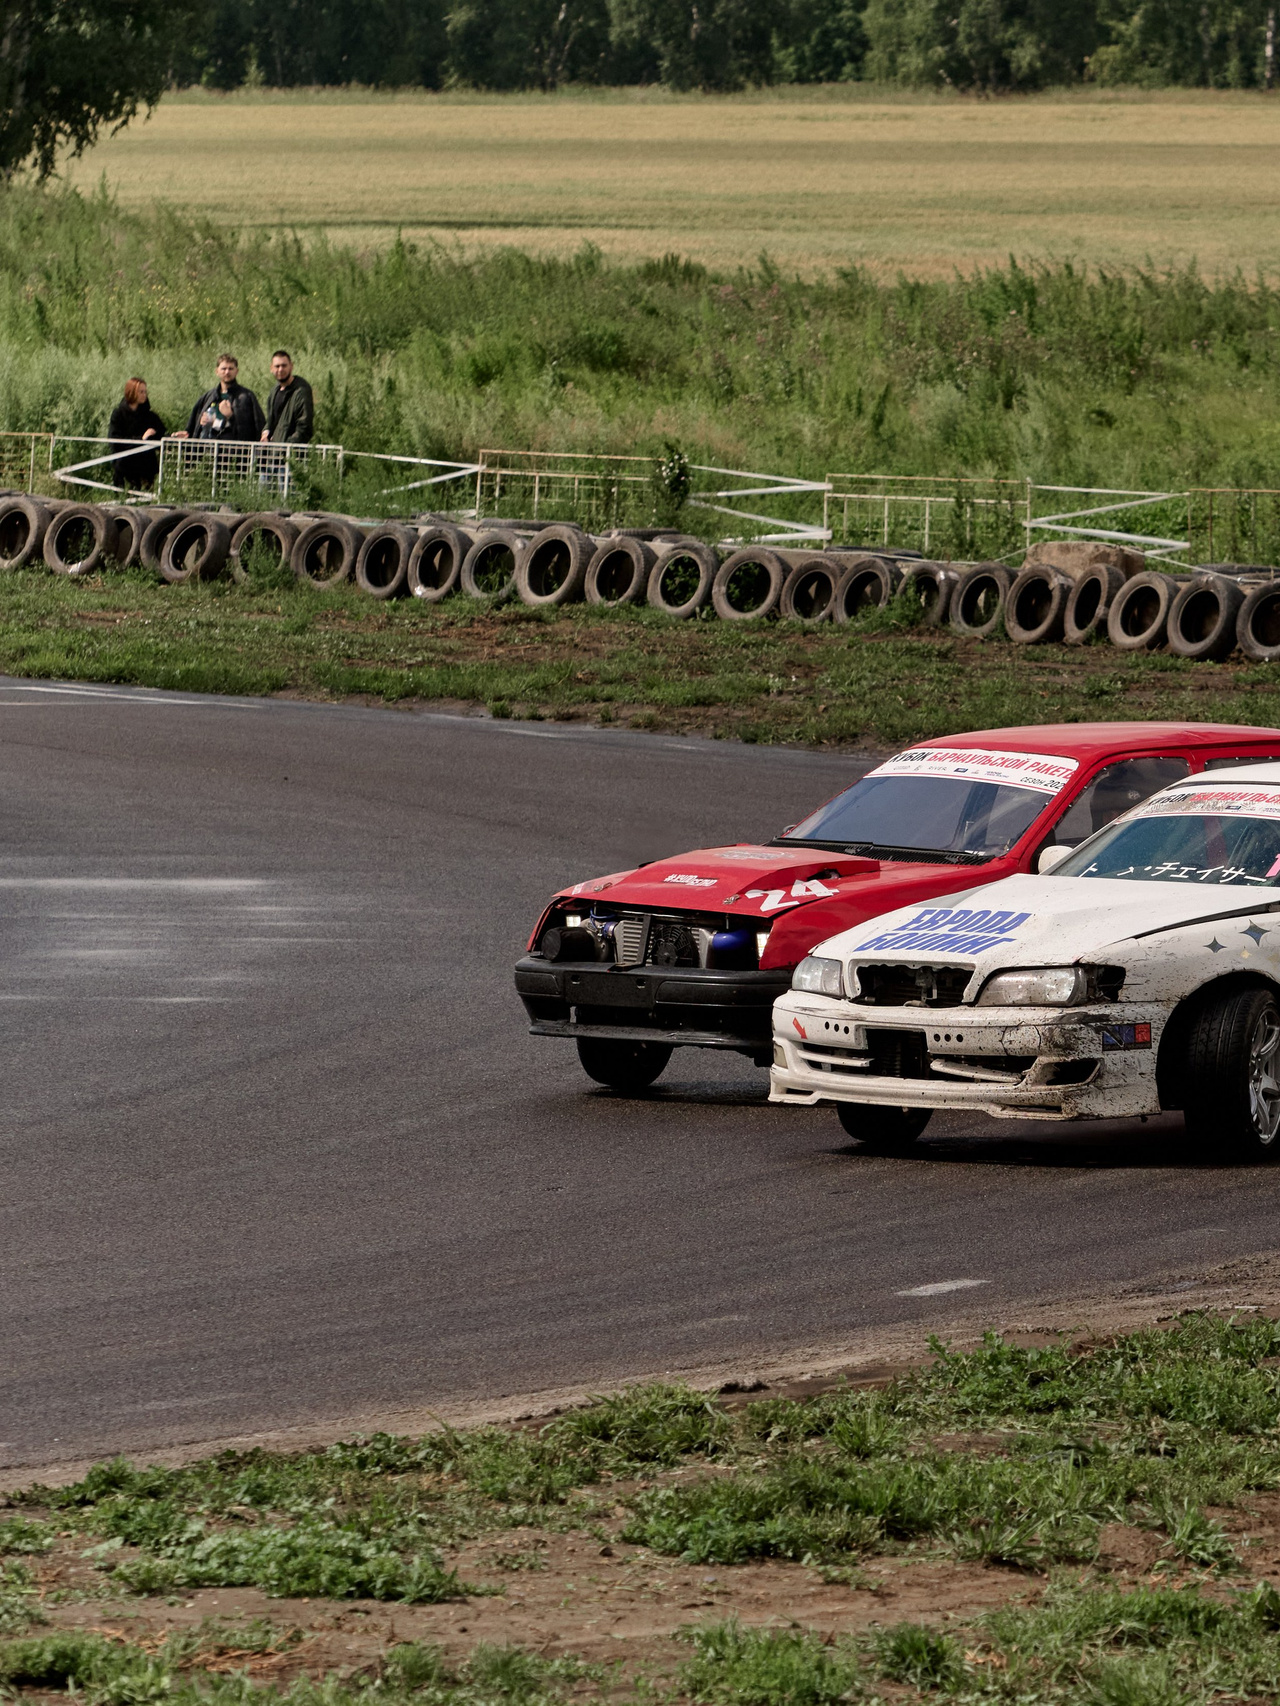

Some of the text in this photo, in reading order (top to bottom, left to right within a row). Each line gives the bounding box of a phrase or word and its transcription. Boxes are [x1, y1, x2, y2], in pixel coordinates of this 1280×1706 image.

[926, 752, 1031, 770] БАРНАУЛЬСКОЙ
[1020, 776, 1066, 791] СЕЗОН 202
[744, 879, 840, 912] 24
[891, 909, 1033, 935] ЕВРОПА
[852, 932, 1018, 956] БОУЛИНГ
